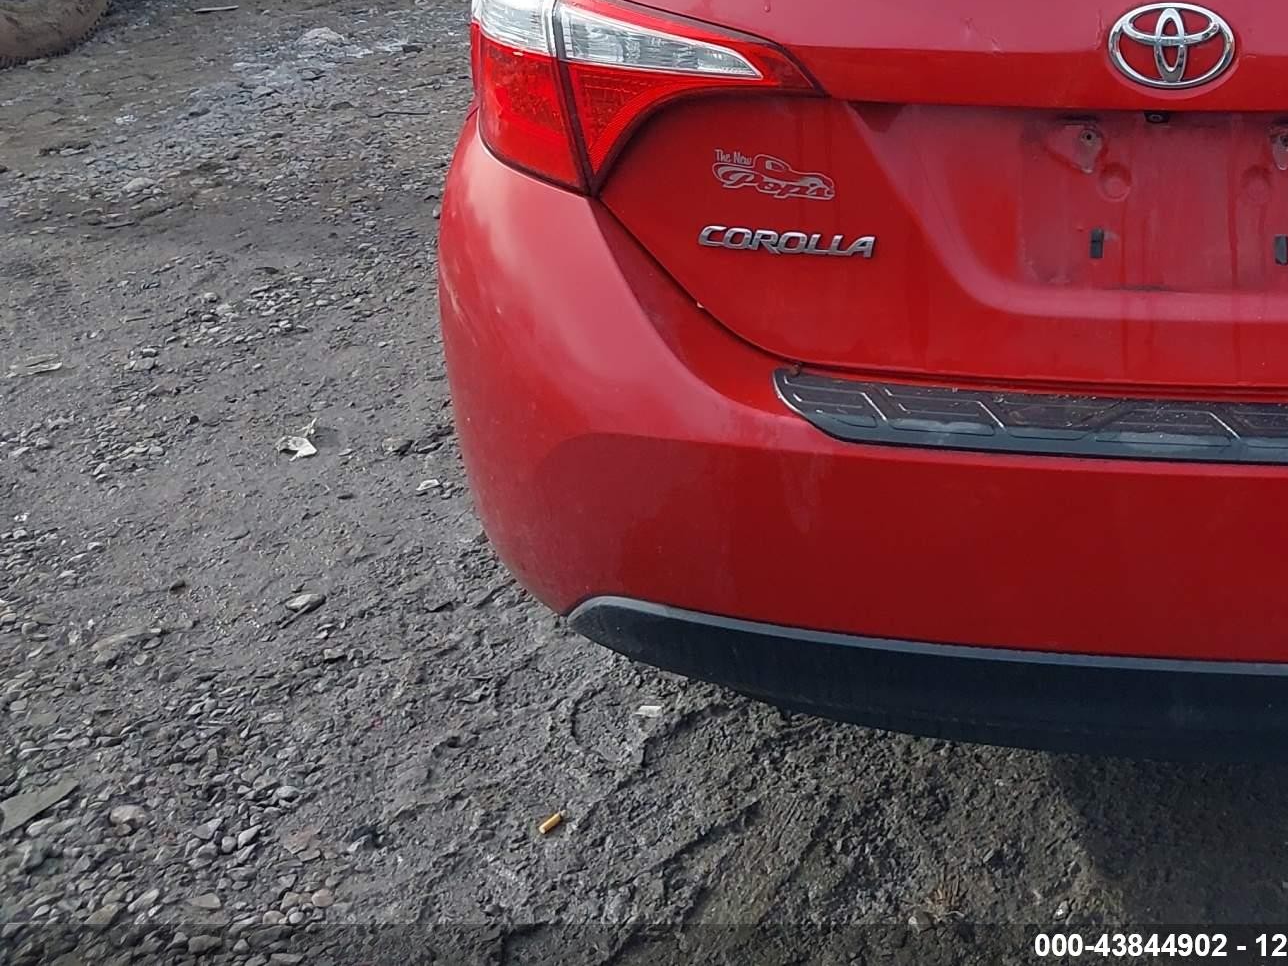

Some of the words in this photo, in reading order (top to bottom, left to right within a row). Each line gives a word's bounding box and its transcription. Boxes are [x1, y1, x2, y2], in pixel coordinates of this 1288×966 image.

[714, 148, 732, 163] The
[733, 151, 752, 166] New
[699, 225, 876, 259] COROLLA
